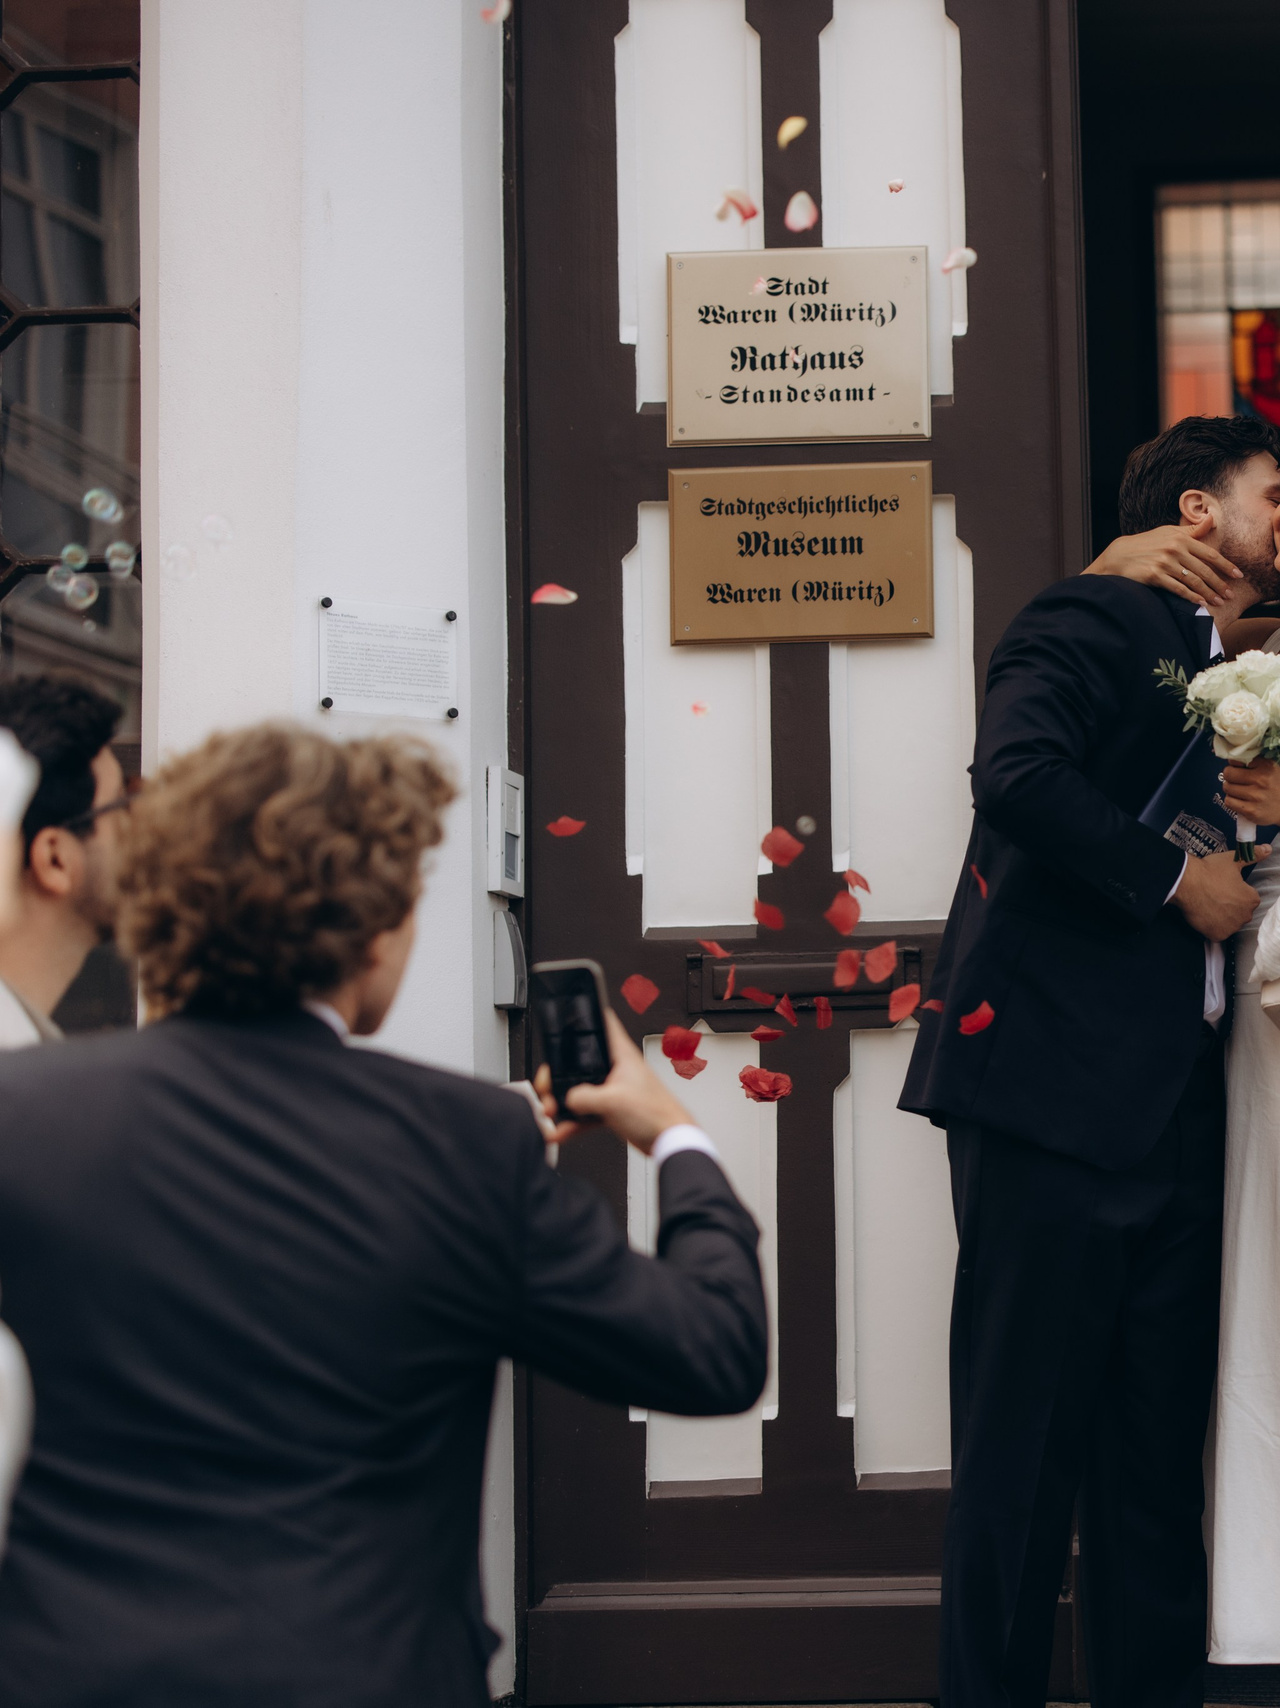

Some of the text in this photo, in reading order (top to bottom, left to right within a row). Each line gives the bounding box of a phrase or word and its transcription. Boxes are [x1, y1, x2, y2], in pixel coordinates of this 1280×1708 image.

[765, 277, 830, 297] Stadt
[697, 301, 897, 327] Waren (Müritz)
[730, 345, 864, 378] Rathaus
[699, 494, 900, 522] Stadtgeschichtliches
[736, 530, 865, 558] Museum
[705, 577, 895, 608] Waren (Müritz)
